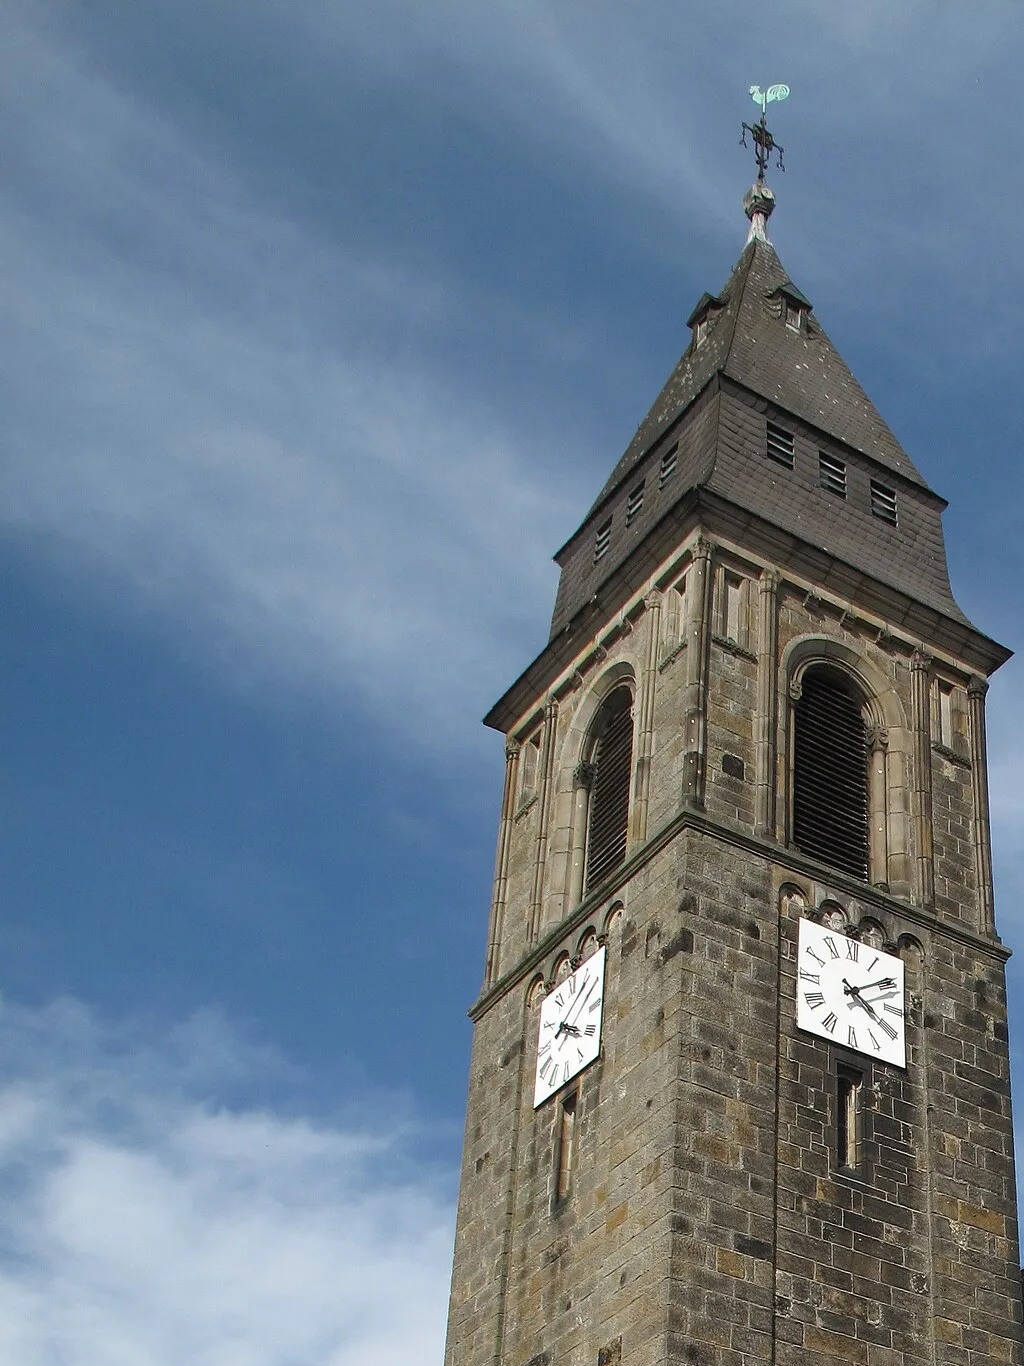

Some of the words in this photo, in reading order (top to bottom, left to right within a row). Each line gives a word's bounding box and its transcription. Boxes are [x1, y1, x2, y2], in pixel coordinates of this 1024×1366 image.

[805, 945, 826, 968] X
[822, 936, 840, 960] XI
[845, 938, 859, 963] XII
[799, 966, 820, 986] IX
[804, 992, 826, 1011] VIII
[821, 1011, 839, 1034] VII
[848, 1025, 859, 1049] VI
[867, 1028, 881, 1051] V
